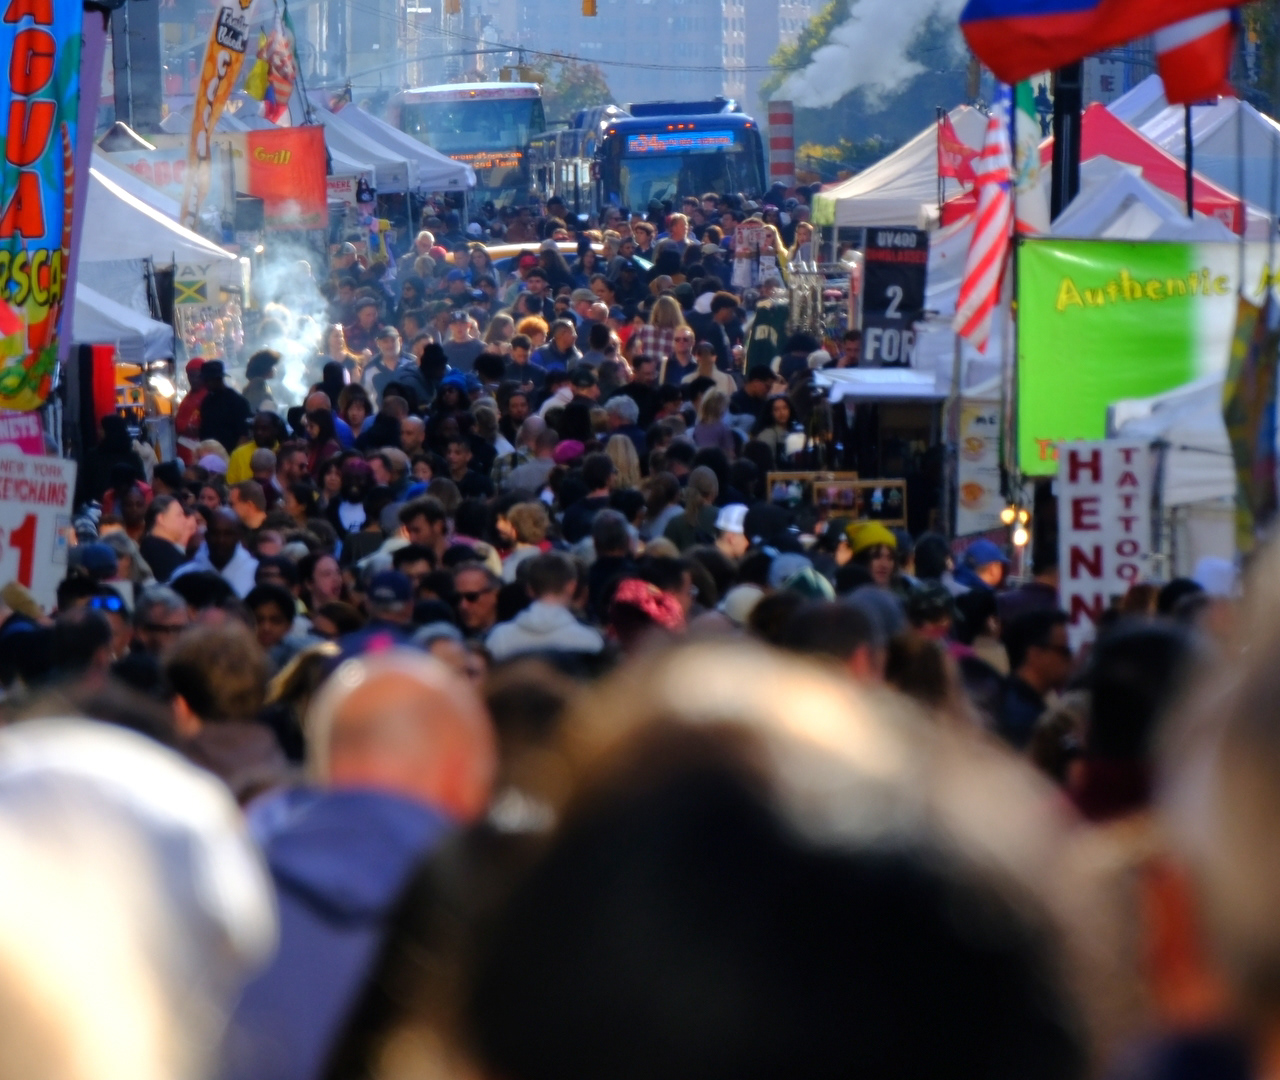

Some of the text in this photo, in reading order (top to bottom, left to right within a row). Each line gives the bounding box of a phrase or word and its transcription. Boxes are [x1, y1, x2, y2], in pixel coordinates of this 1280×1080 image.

[253, 146, 292, 165] Grill
[877, 230, 917, 248] UV400
[884, 285, 905, 319] 2
[1054, 267, 1233, 313] Authentic
[0, 458, 64, 478] NEW YORK
[1116, 448, 1140, 582] TATTOO
[1068, 449, 1104, 628] HENN
